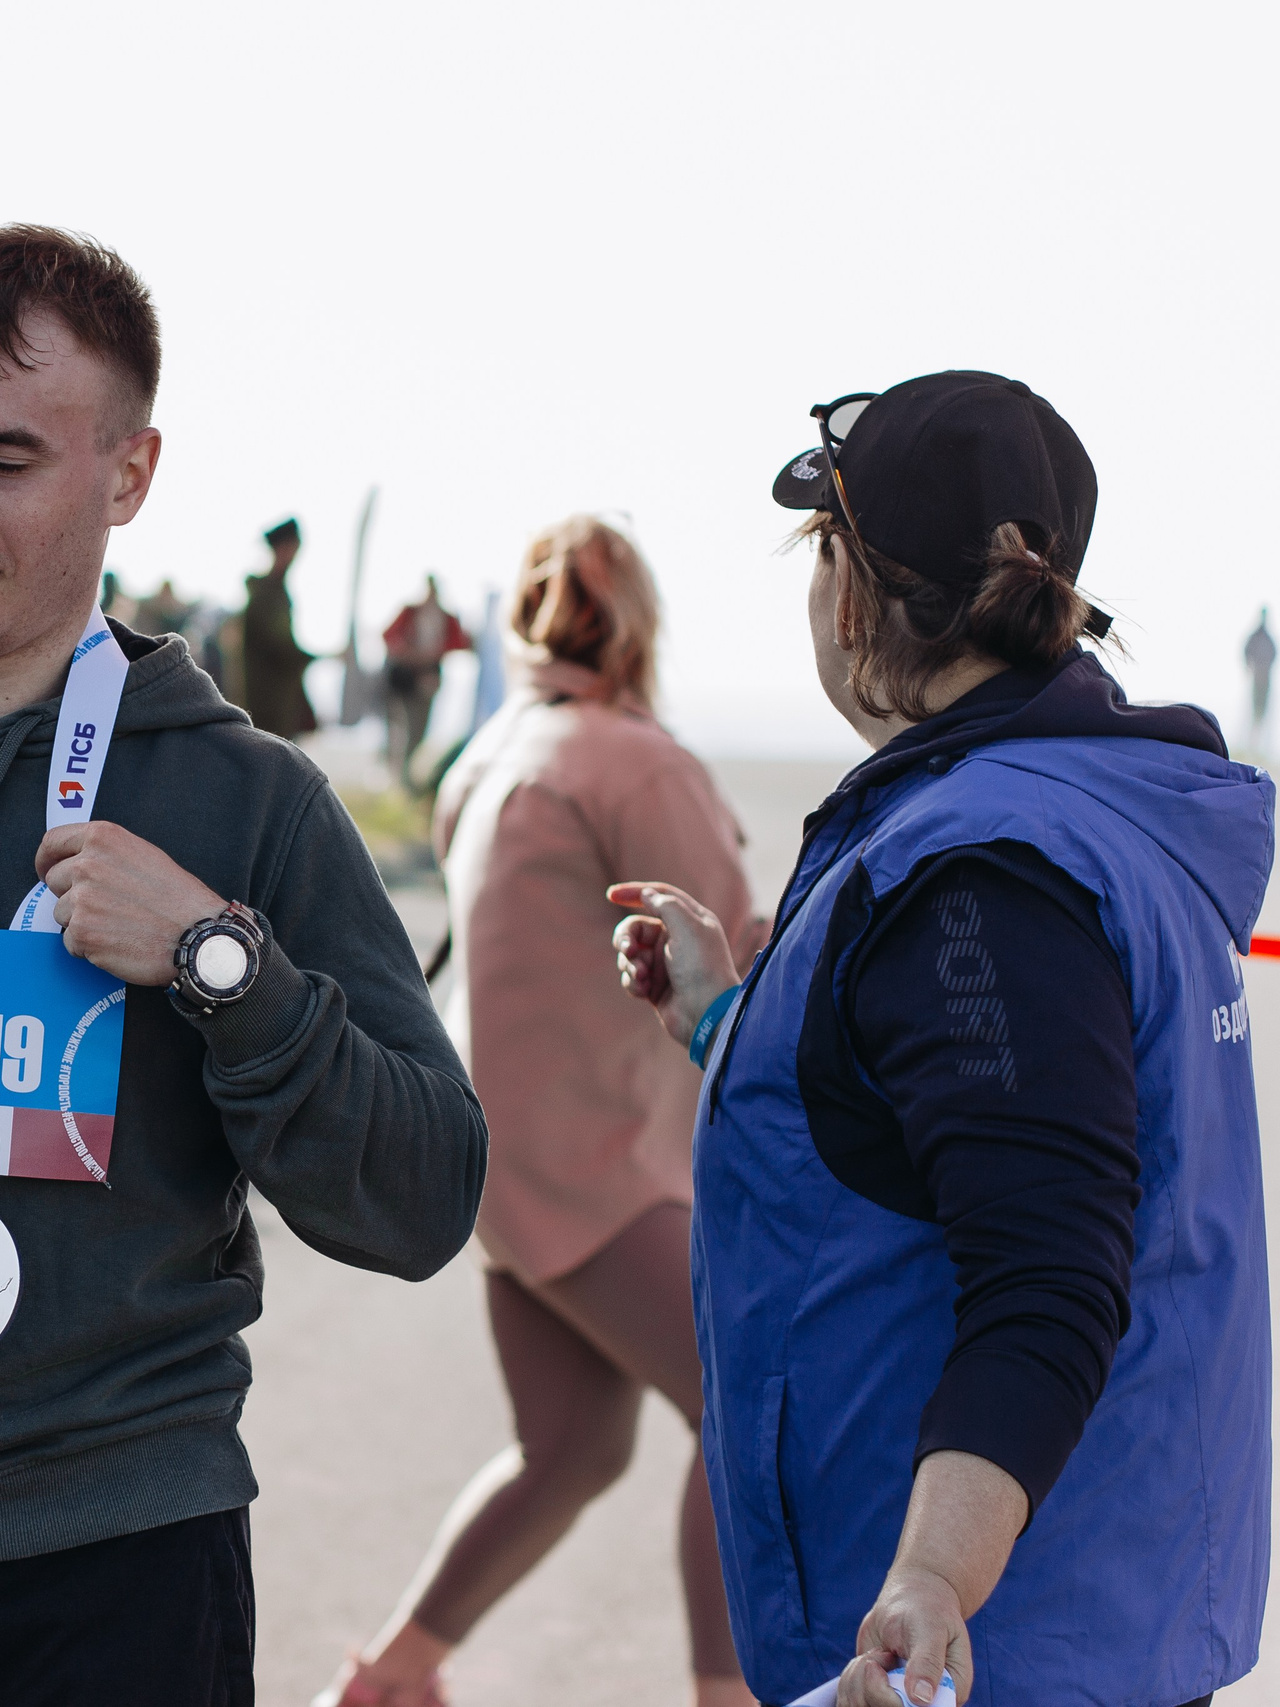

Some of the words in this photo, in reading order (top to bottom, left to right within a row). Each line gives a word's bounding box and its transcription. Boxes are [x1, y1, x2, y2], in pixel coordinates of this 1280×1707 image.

[65, 722, 96, 775] ПСБ
[61, 997, 111, 1065] #САМОВЫРАЖЕНИЕ
[1211, 988, 1249, 1043] ОЗД
[58, 1064, 72, 1112] #ГОРДОСТЬ
[62, 1111, 89, 1157] #ЕДИНСТВО
